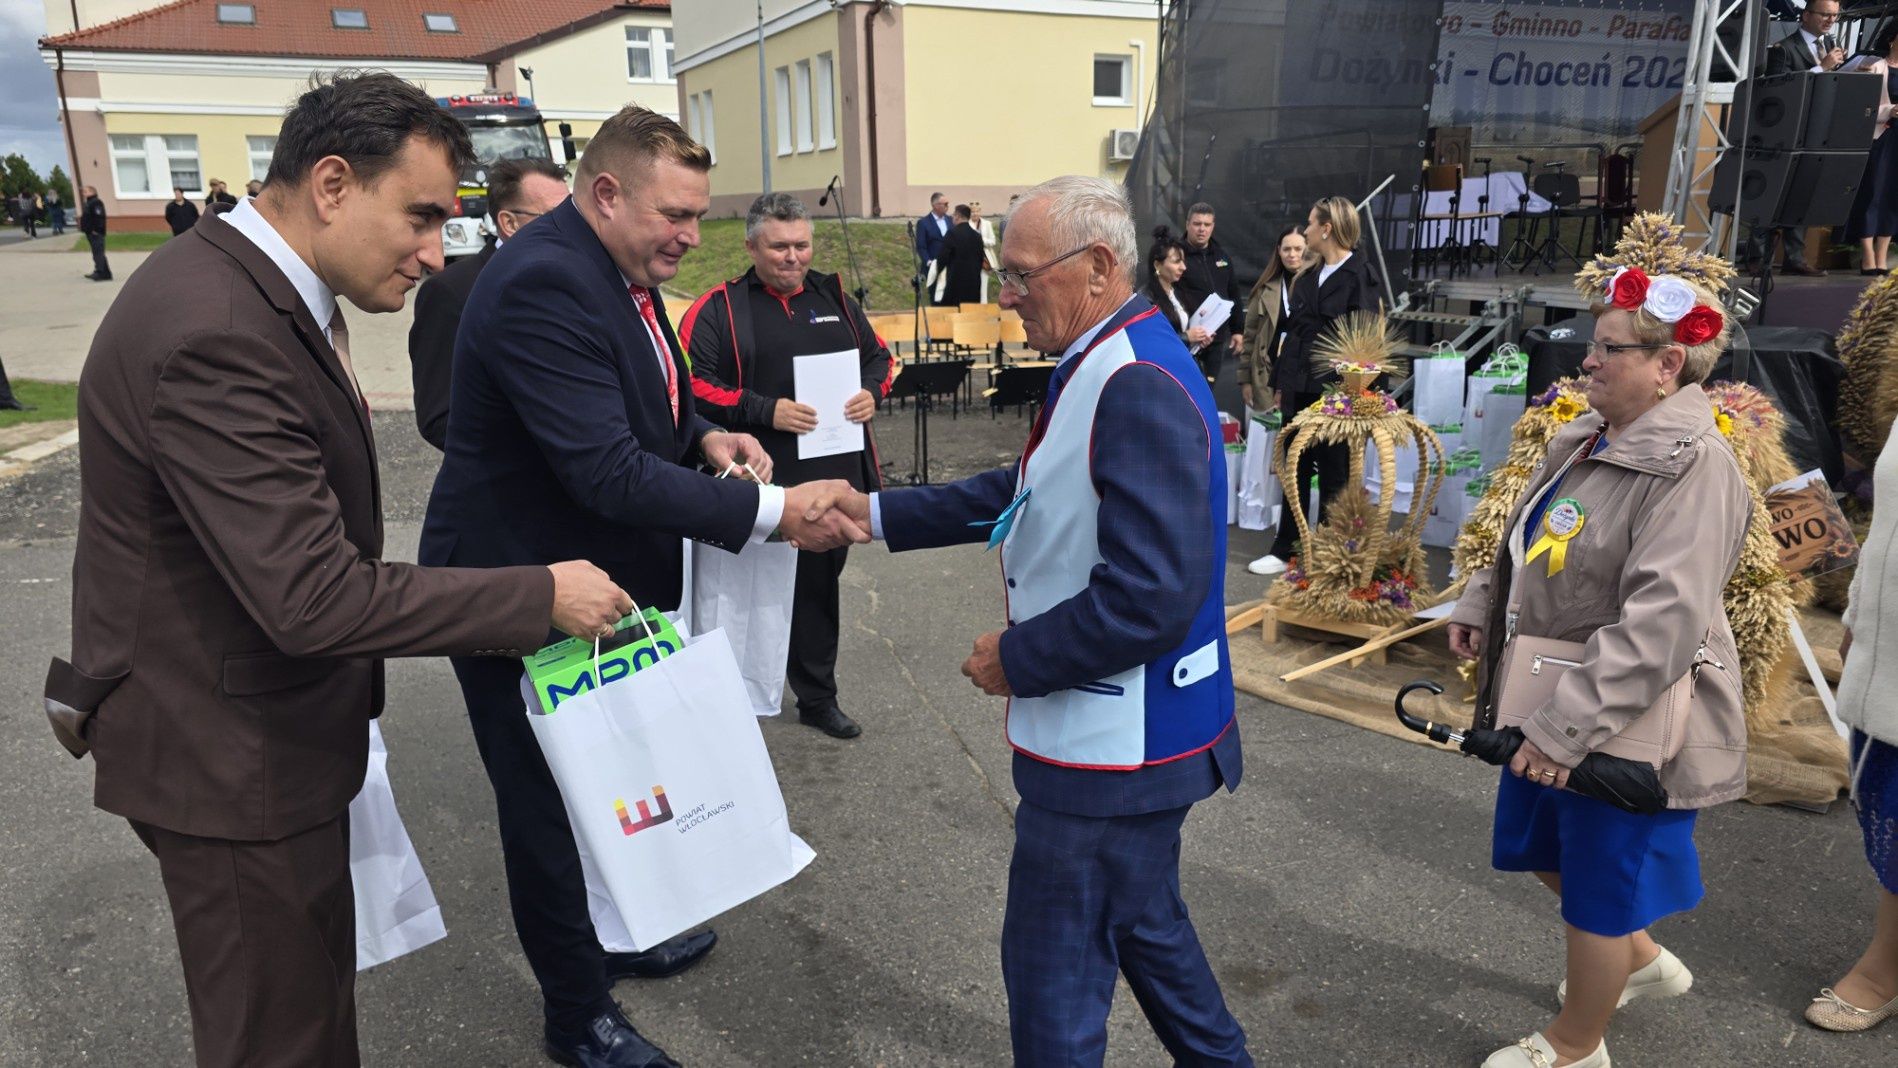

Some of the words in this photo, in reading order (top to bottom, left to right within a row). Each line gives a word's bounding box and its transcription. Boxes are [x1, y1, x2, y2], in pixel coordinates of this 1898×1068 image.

[1492, 10, 1583, 37] Gminno
[1489, 50, 1612, 87] Choceń
[675, 803, 706, 826] POWIAT
